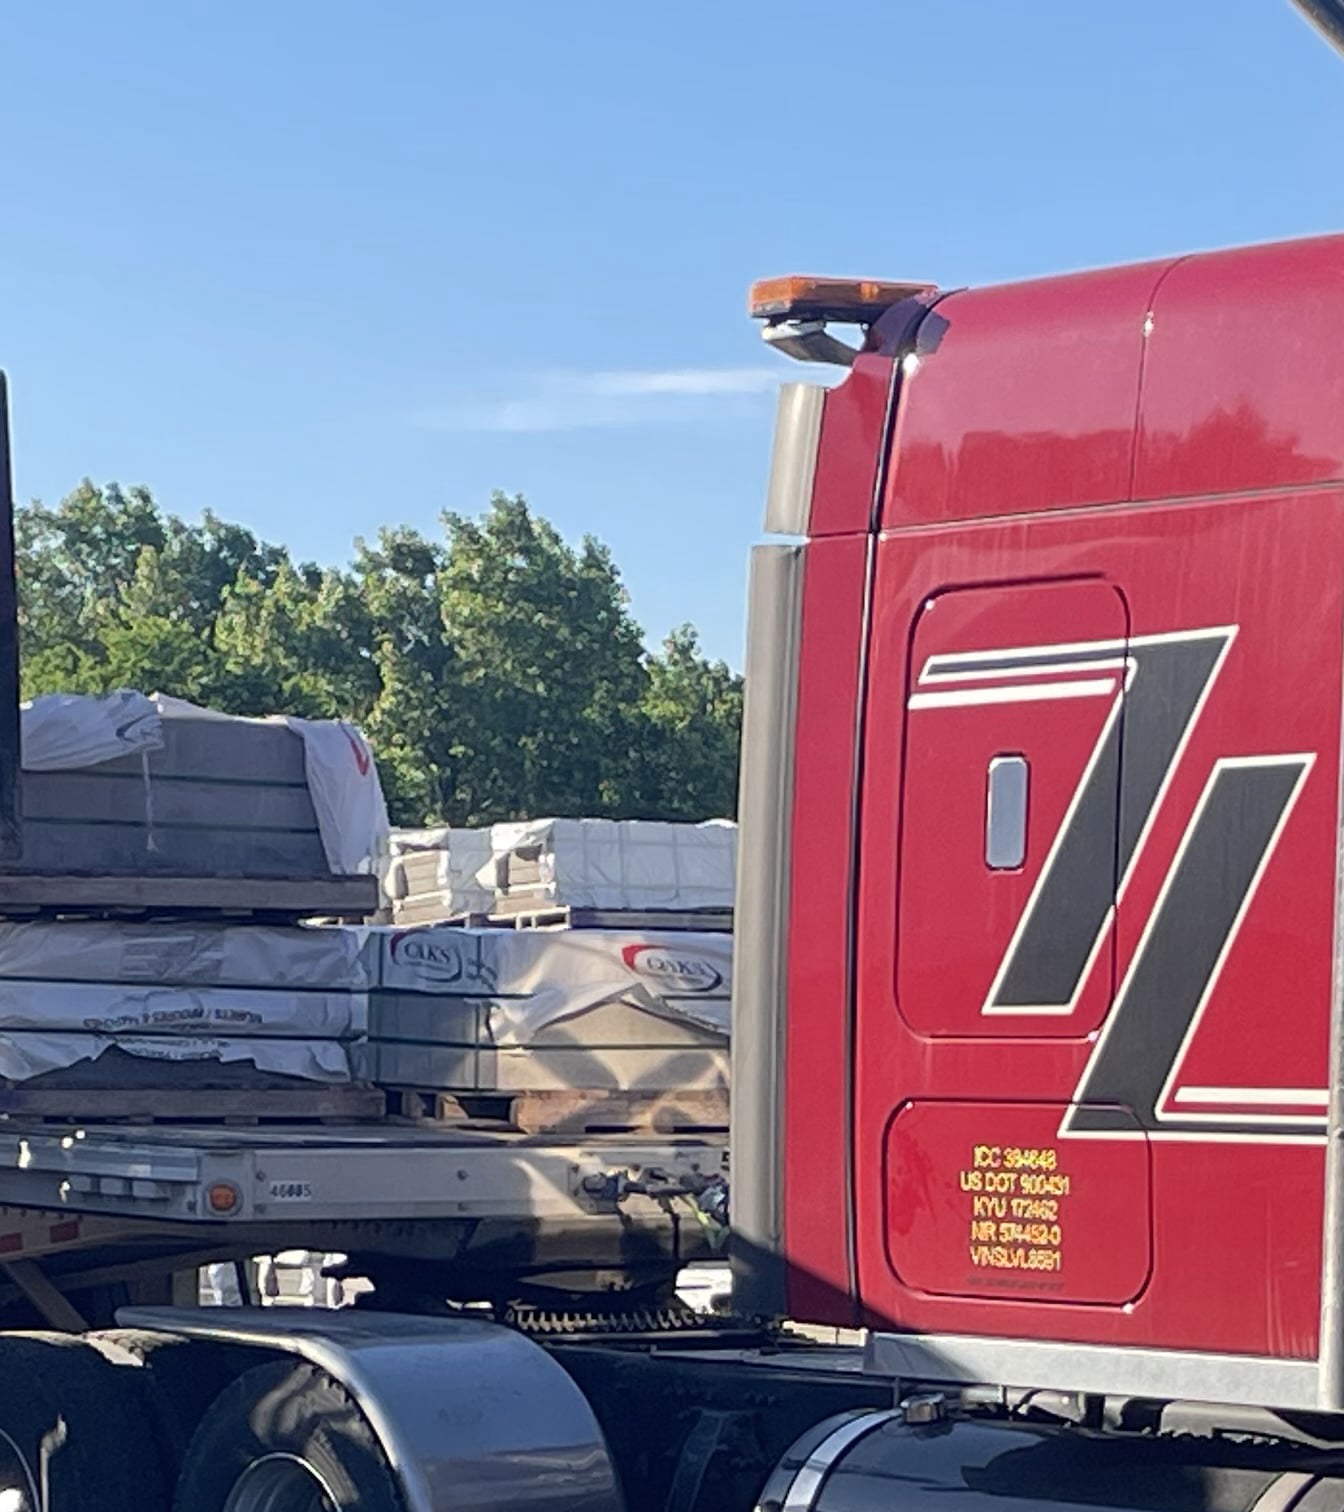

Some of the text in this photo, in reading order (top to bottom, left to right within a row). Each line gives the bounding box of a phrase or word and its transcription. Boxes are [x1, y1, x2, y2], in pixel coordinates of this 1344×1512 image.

[960, 1170, 983, 1192] US
[984, 1172, 1017, 1193] DOT
[973, 1196, 1007, 1218] KYU
